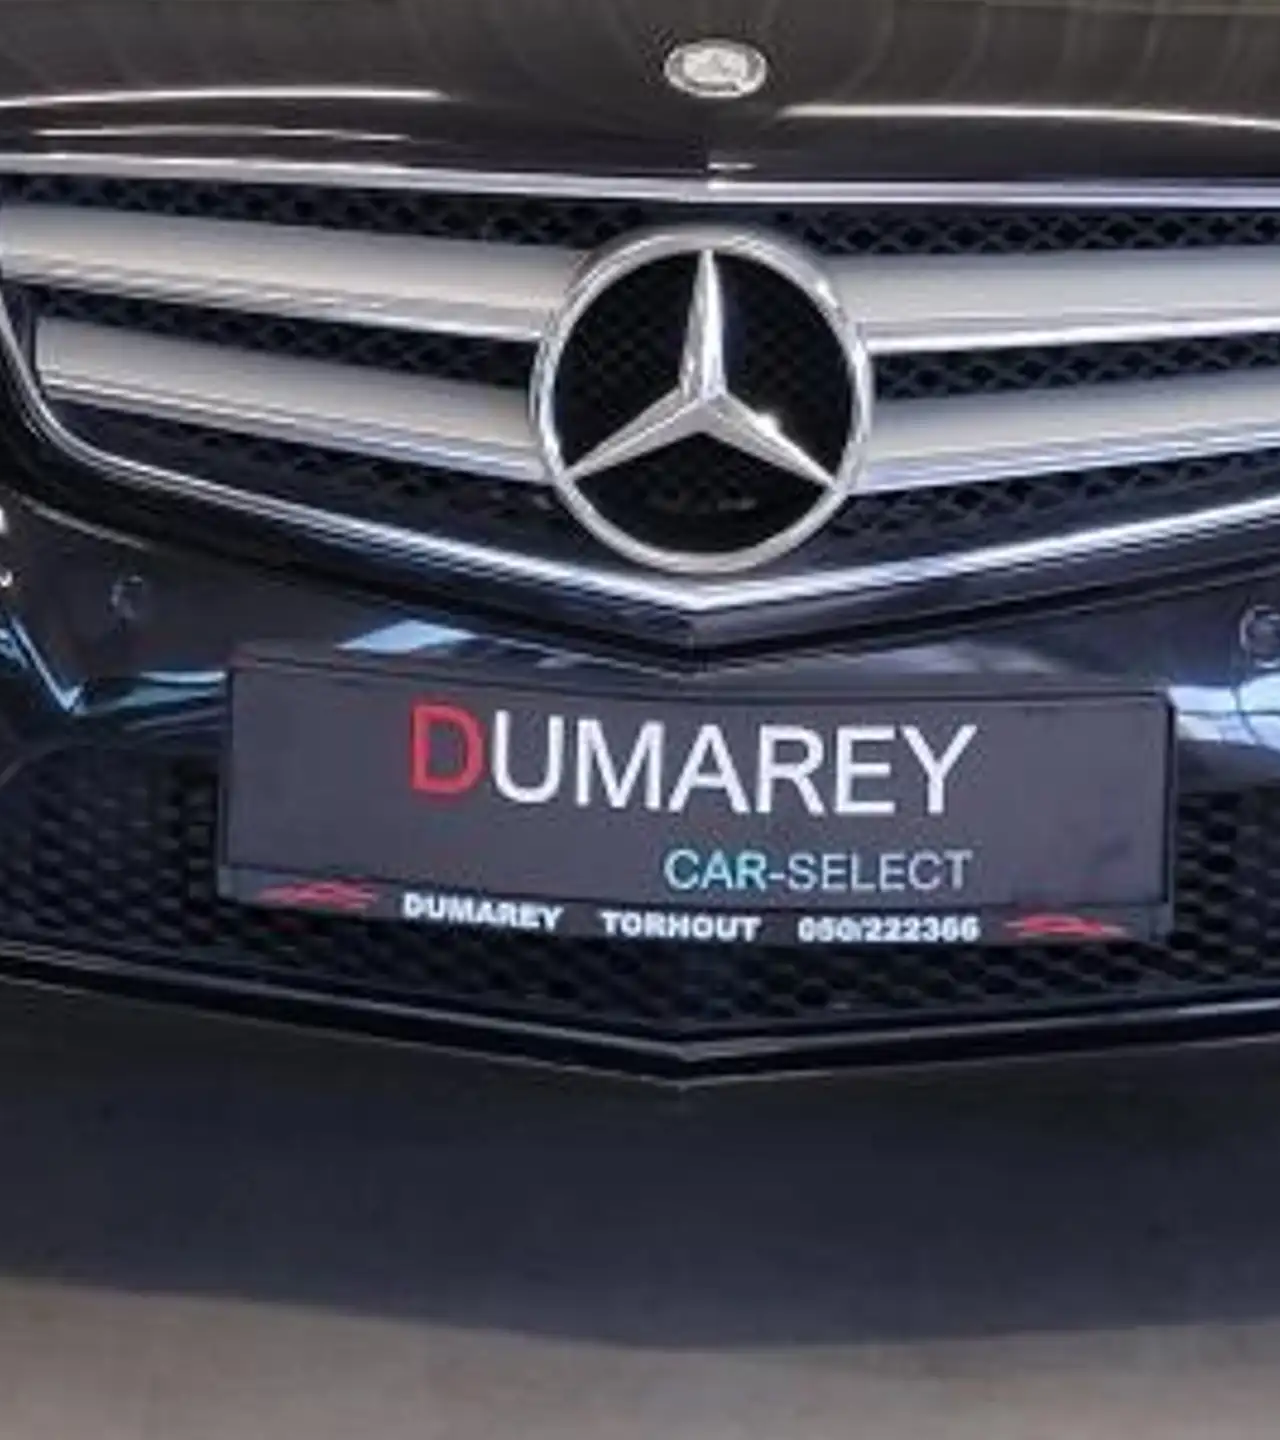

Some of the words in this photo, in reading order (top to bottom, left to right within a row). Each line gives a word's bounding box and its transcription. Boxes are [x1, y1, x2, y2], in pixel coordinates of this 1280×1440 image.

[408, 702, 978, 815] DUMAREY
[663, 849, 973, 892] CAR-SELECT
[402, 891, 565, 932] DUMAREY
[599, 909, 762, 942] TORHOUT
